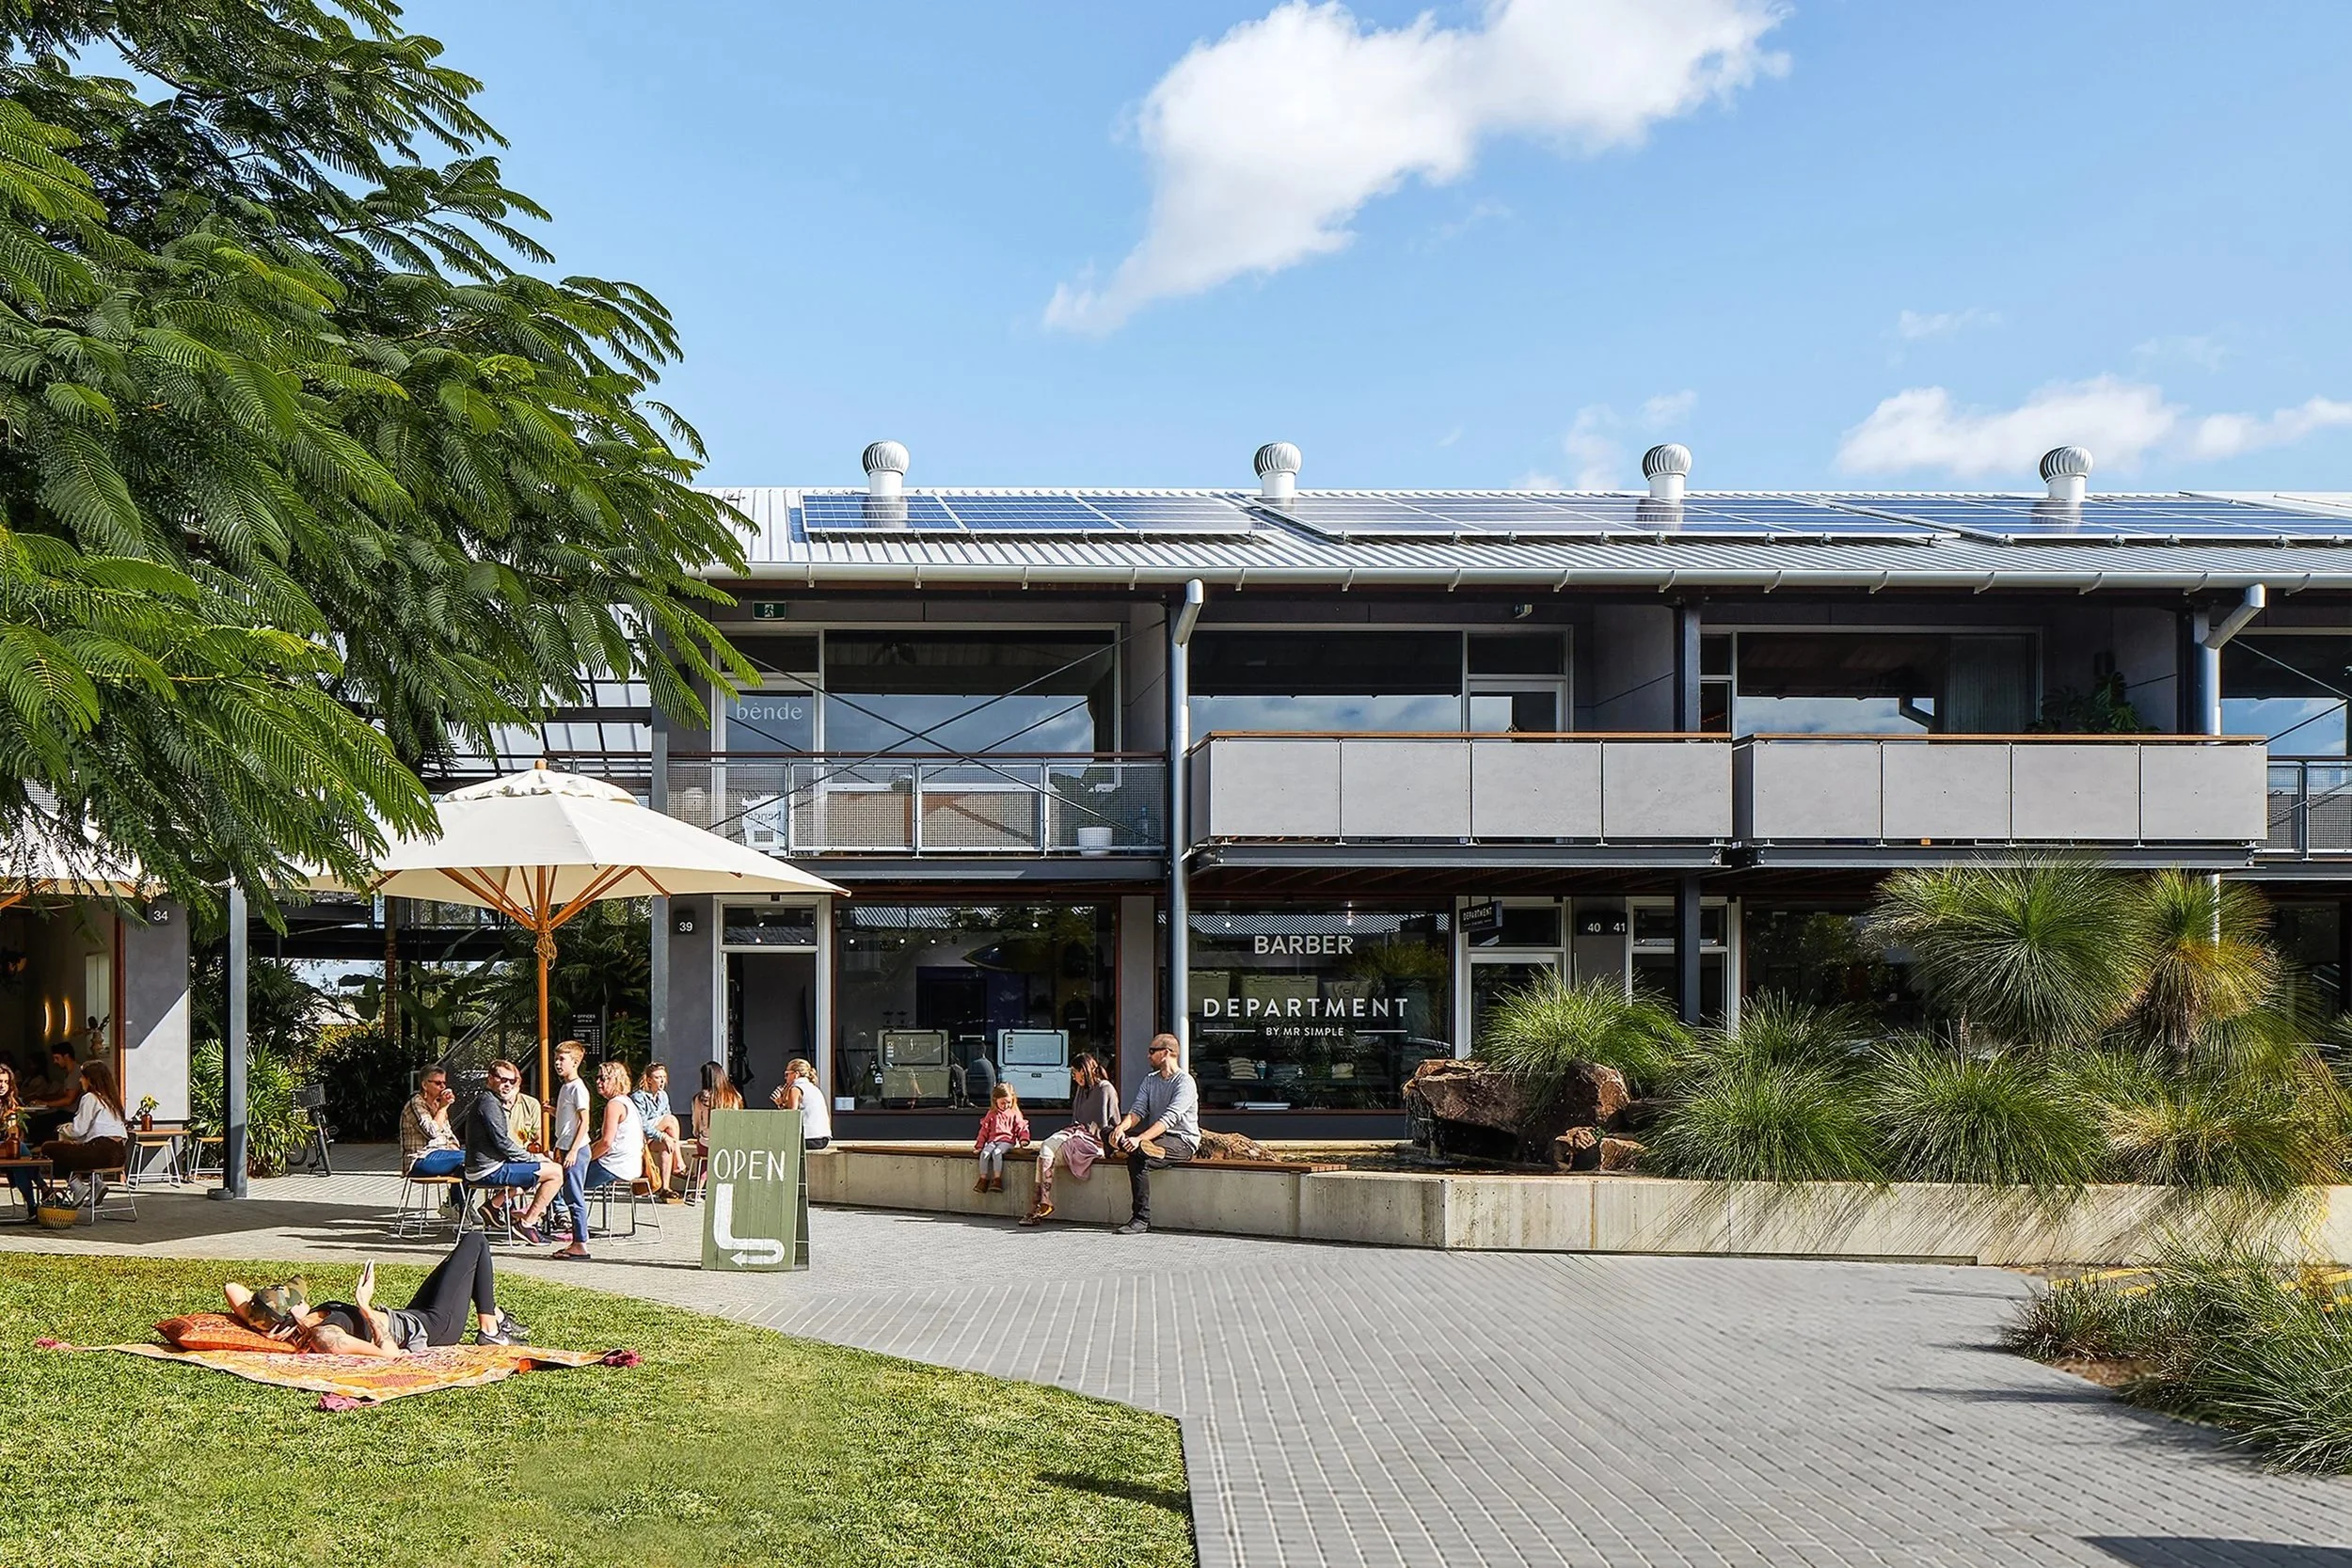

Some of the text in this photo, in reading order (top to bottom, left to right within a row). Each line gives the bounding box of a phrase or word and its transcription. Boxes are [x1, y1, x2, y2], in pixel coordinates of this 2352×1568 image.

[153, 910, 168, 921] 34
[679, 921, 692, 931] 39
[1587, 922, 1601, 932] 40
[1613, 922, 1626, 932] 41
[1254, 935, 1354, 955] BARBER
[1203, 998, 1408, 1018] DEPARTMENT
[1265, 1027, 1344, 1037] BY MR SIMPLE
[713, 1148, 786, 1181] OPEN
